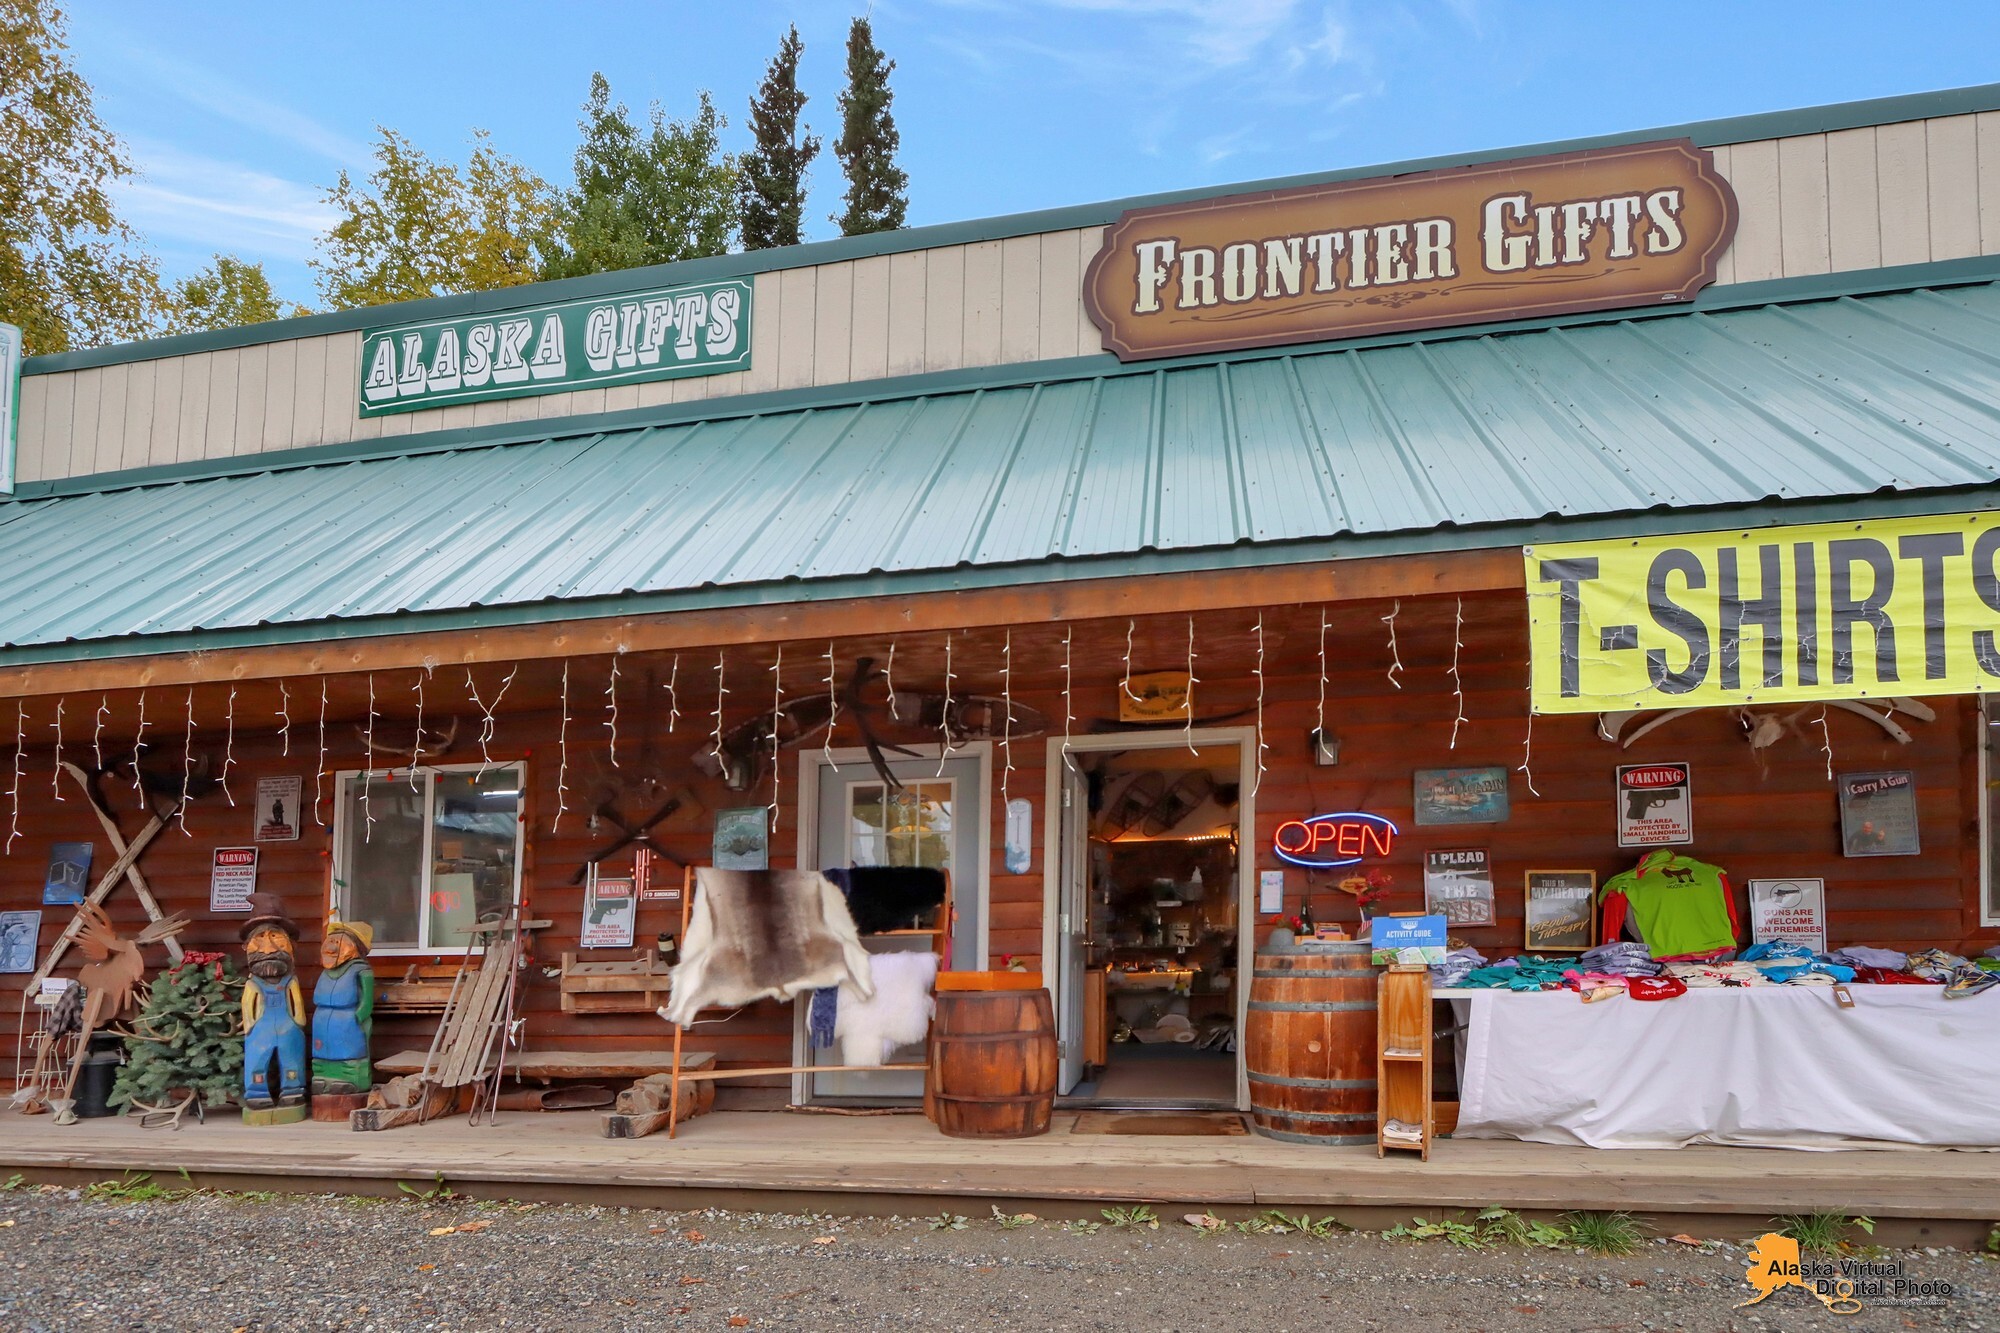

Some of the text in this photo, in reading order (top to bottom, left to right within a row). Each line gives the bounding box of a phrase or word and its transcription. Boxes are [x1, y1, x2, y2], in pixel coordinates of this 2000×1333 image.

[1131, 189, 1685, 314] FRONTIER GIFTS
[364, 287, 741, 401] ALASKA GIFTS
[1626, 771, 1681, 784] WARNING
[1845, 775, 1909, 796] I Carry A Gun
[1274, 820, 1392, 856] OPEN
[219, 854, 252, 863] WARNING
[1431, 852, 1485, 865] I PLEAD
[596, 884, 631, 895] ARNING
[1541, 879, 1565, 887] THIS IS
[1441, 884, 1478, 899] THE
[1532, 887, 1547, 900] MY
[1551, 888, 1574, 899] IDEA
[1531, 915, 1571, 932] GROUP
[1764, 917, 1814, 925] WELCOME
[1386, 929, 1432, 938] ACTIVITY GUIDE
[1538, 918, 1590, 940] THERAPY
[1773, 925, 1822, 933] PREMISES
